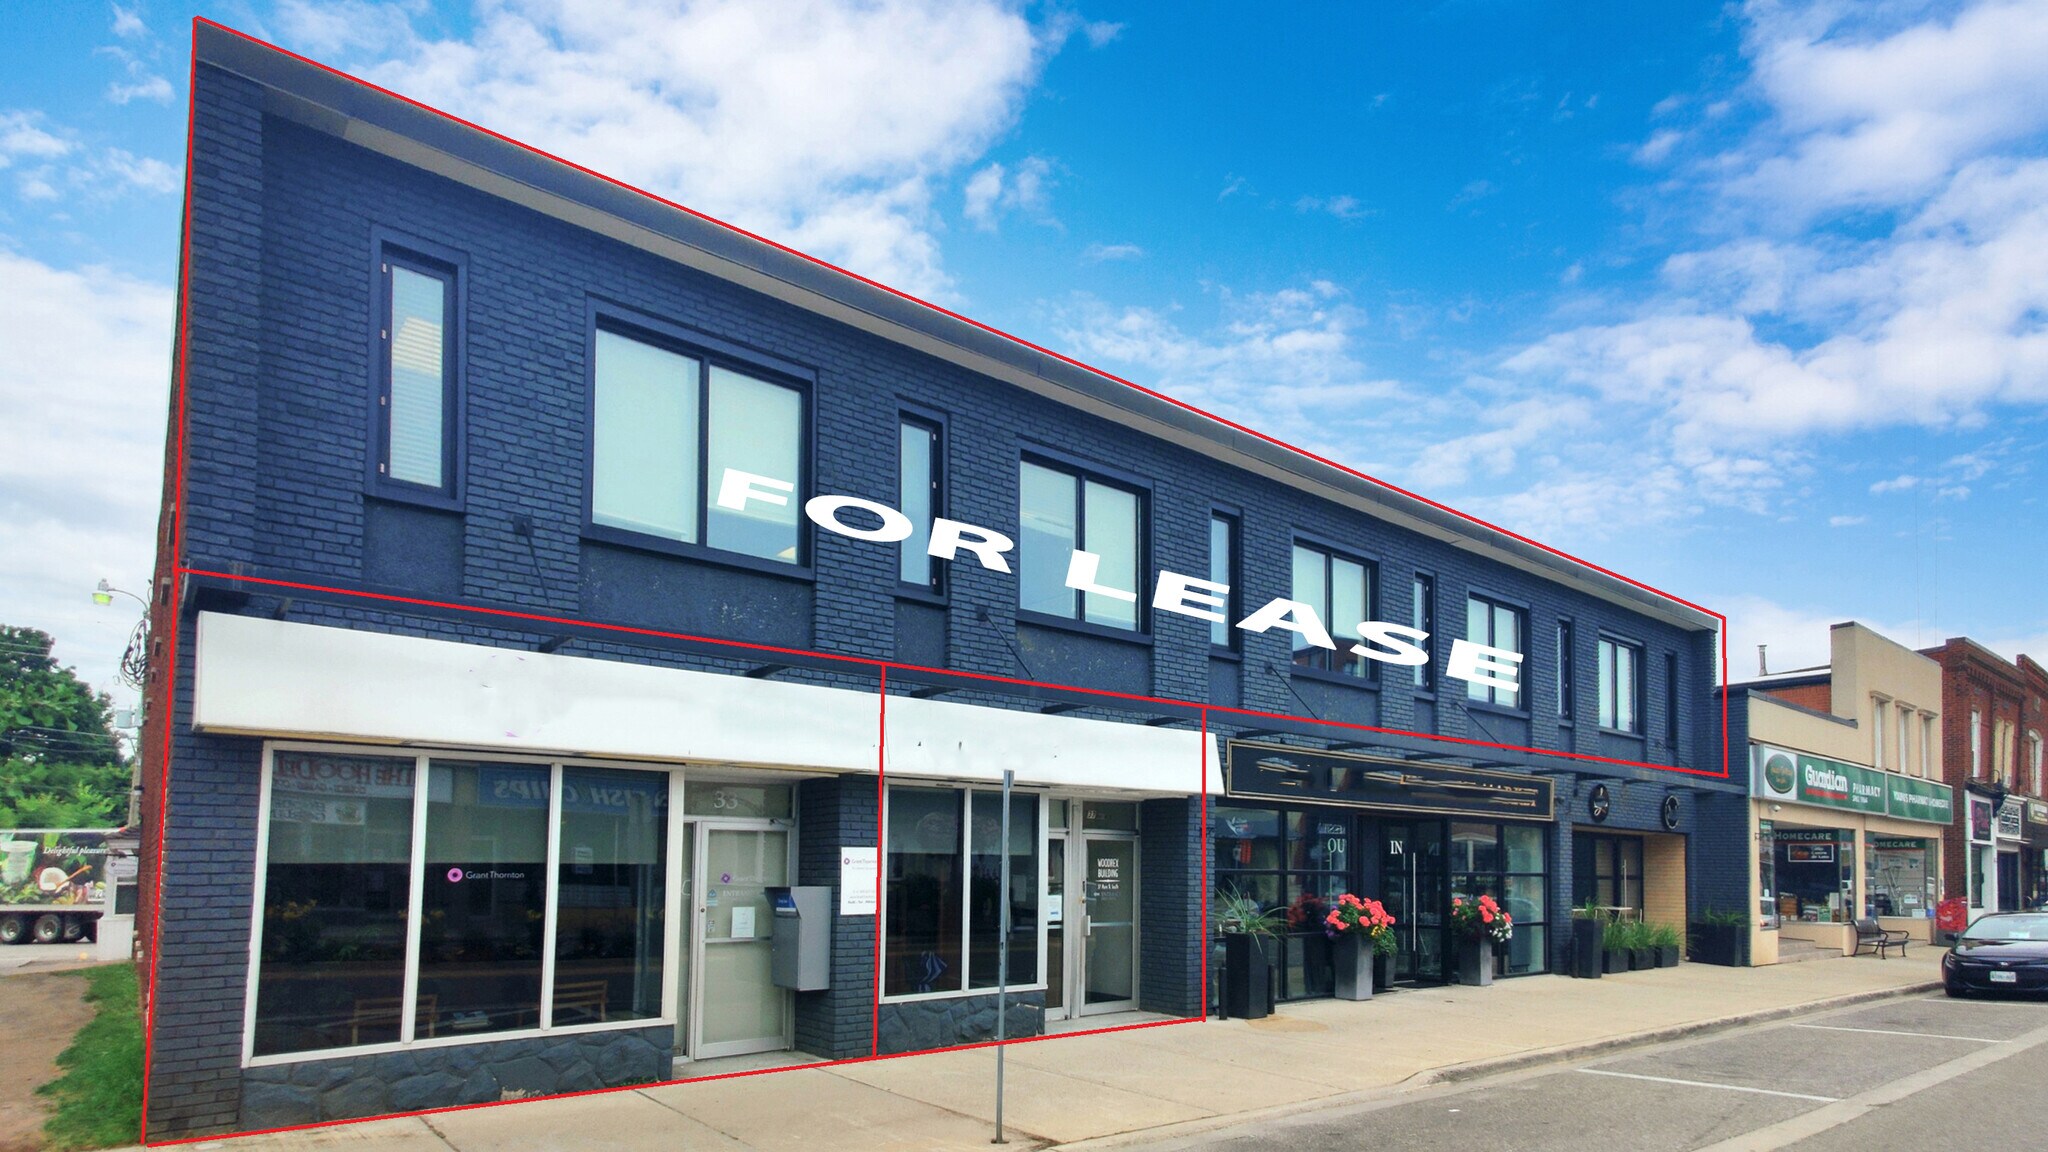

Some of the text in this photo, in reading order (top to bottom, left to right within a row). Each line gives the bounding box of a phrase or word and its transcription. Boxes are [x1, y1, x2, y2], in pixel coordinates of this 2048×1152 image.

[1805, 765, 1848, 792] Guardian
[79, 846, 107, 857] pleasur
[1390, 840, 1403, 854] IN
[465, 870, 525, 879] Grant Thornton
[1097, 869, 1119, 878] BUILDING
